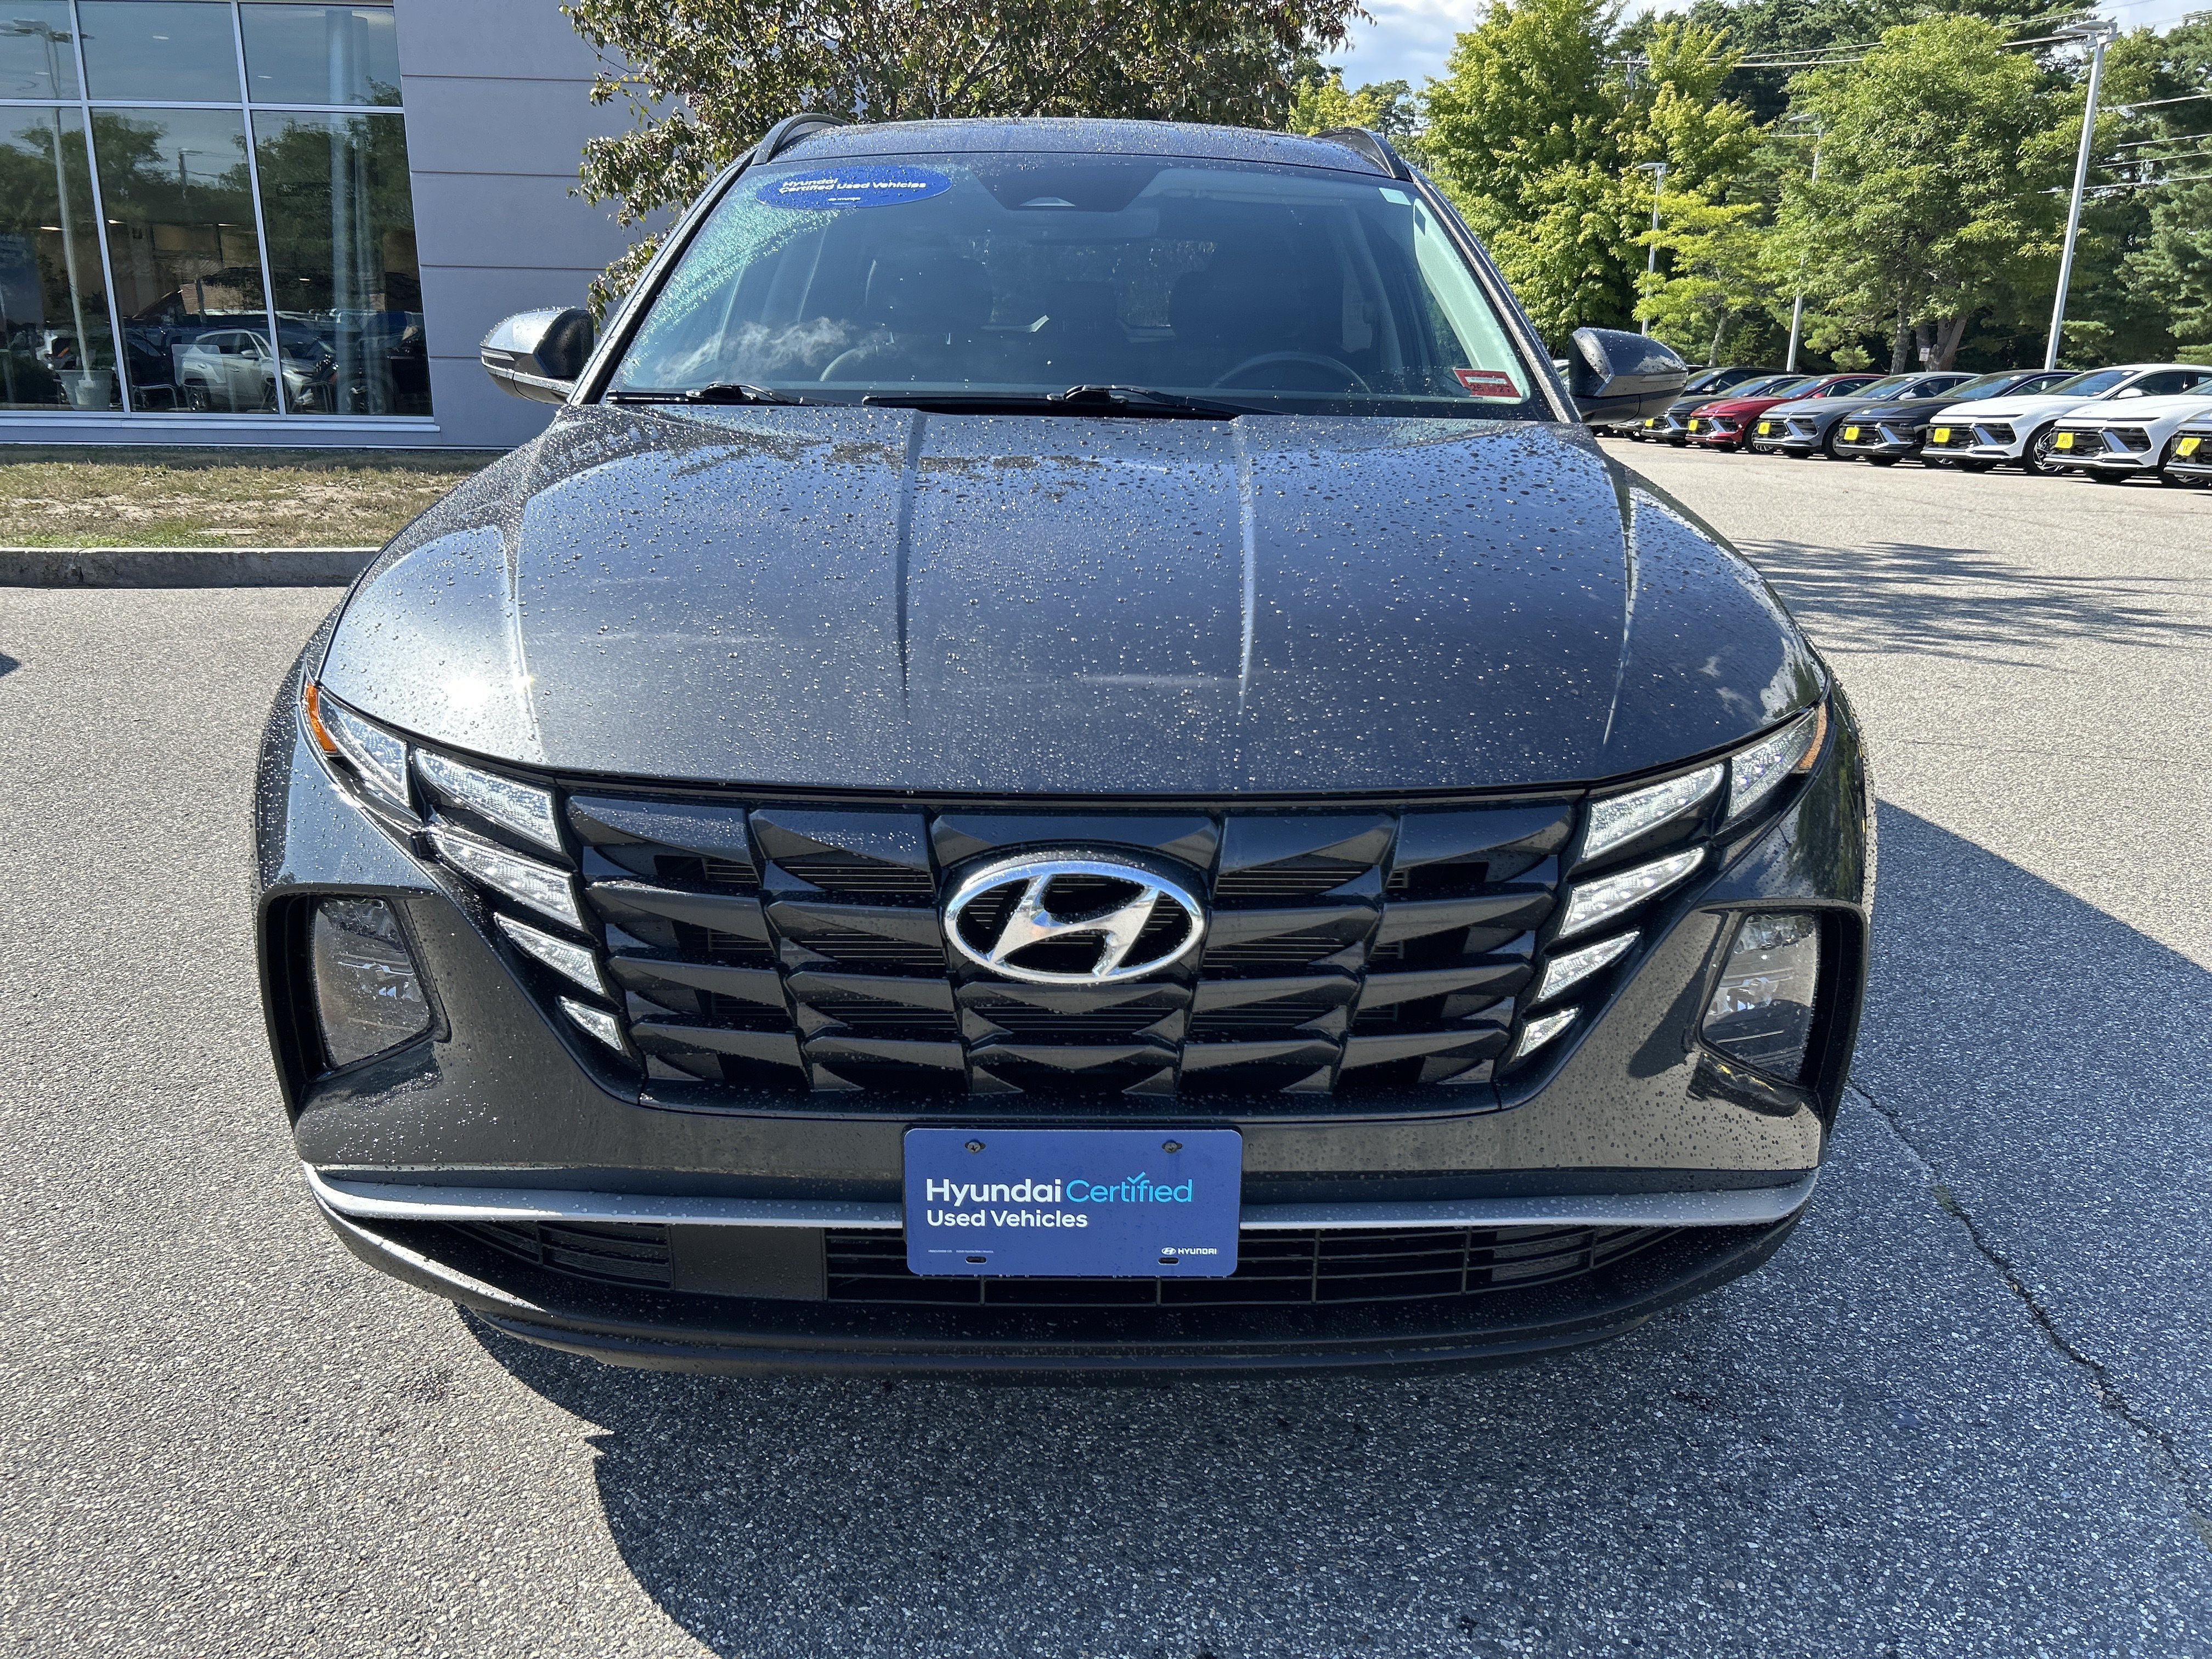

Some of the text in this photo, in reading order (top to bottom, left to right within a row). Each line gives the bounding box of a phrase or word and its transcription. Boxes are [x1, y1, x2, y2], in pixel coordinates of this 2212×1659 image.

[778, 184, 835, 193] Certified
[782, 178, 839, 187] Hyundai
[926, 1172, 1193, 1207] Hyundai Certified
[927, 1209, 1088, 1228] Used Vehicles
